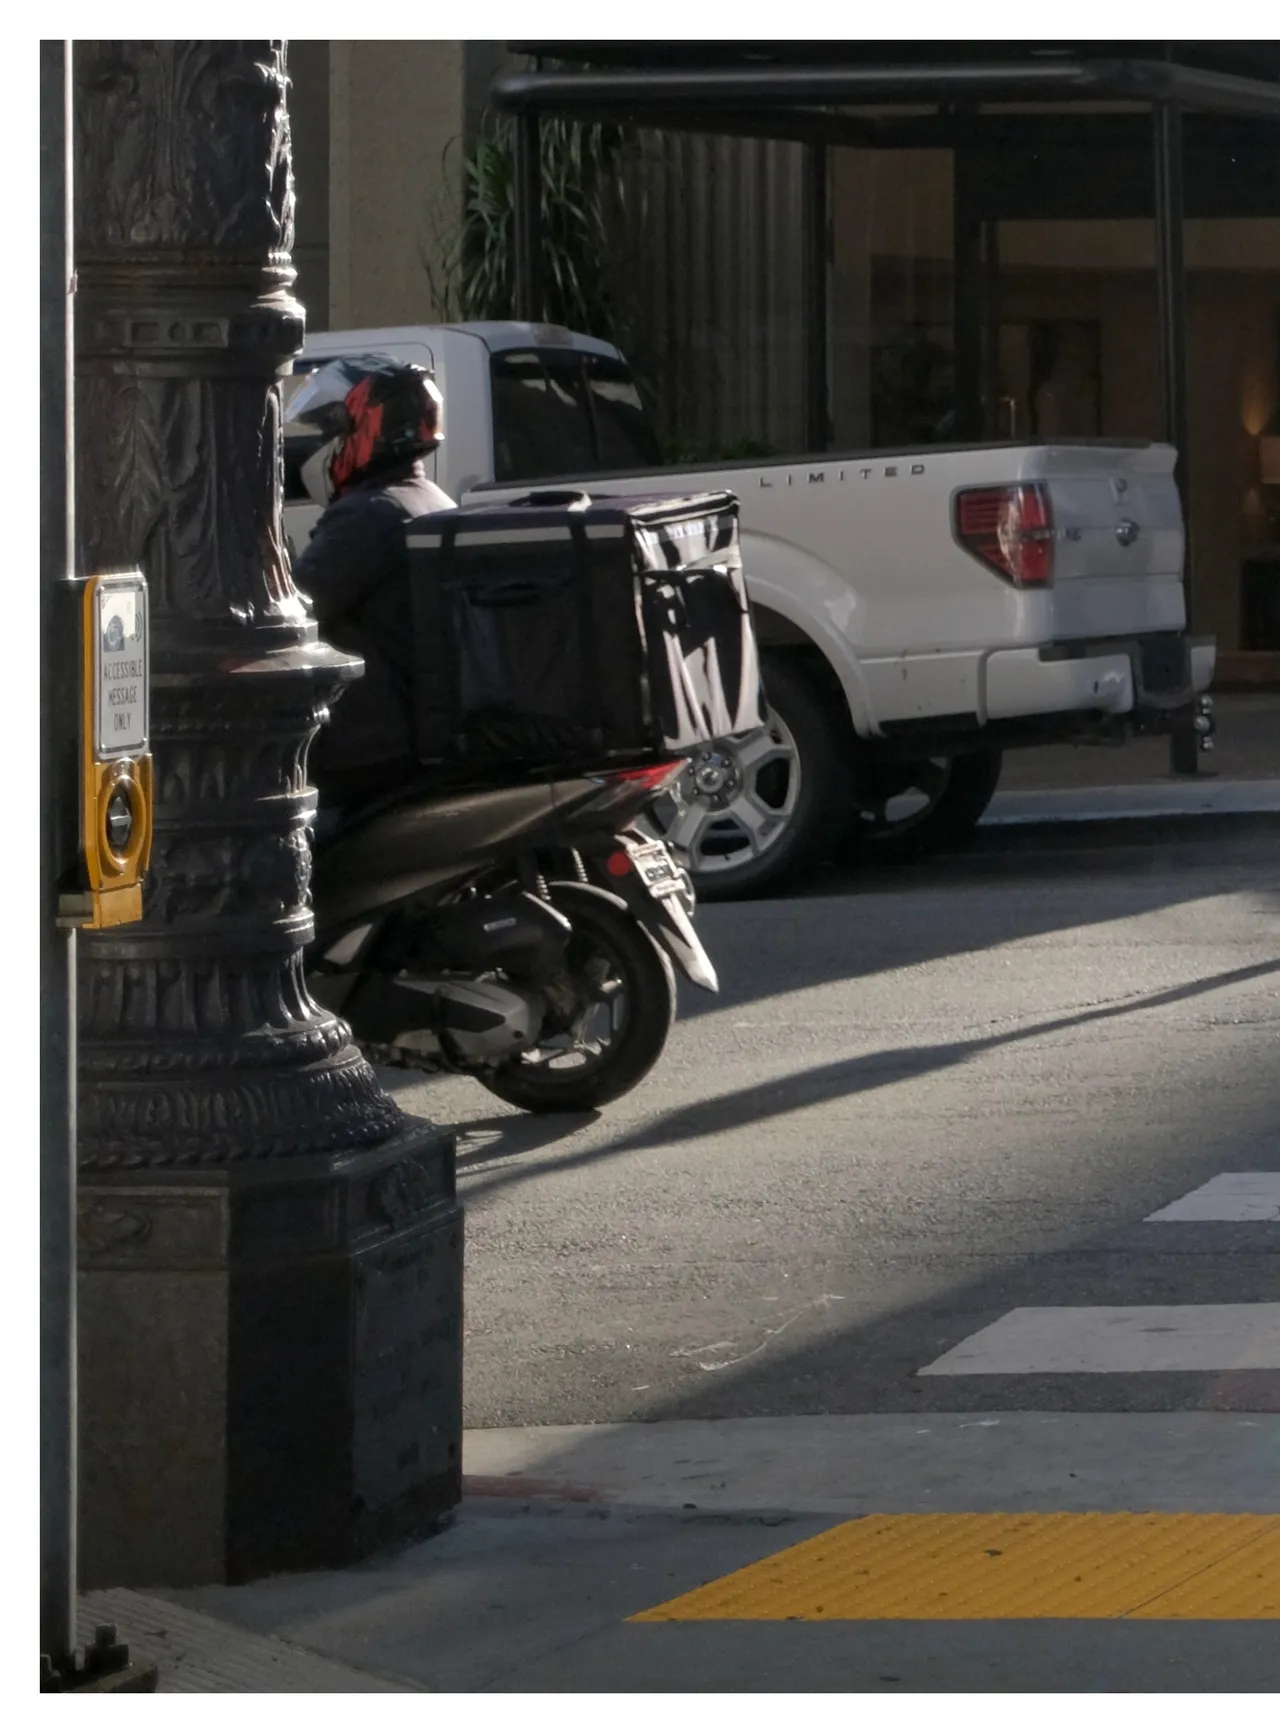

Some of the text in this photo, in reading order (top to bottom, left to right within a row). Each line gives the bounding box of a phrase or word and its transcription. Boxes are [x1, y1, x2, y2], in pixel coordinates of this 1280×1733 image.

[759, 464, 926, 489] LIMITED
[103, 659, 143, 682] ACCESSIBLE
[108, 685, 138, 706] MESSAGE
[113, 712, 132, 732] ONLY
